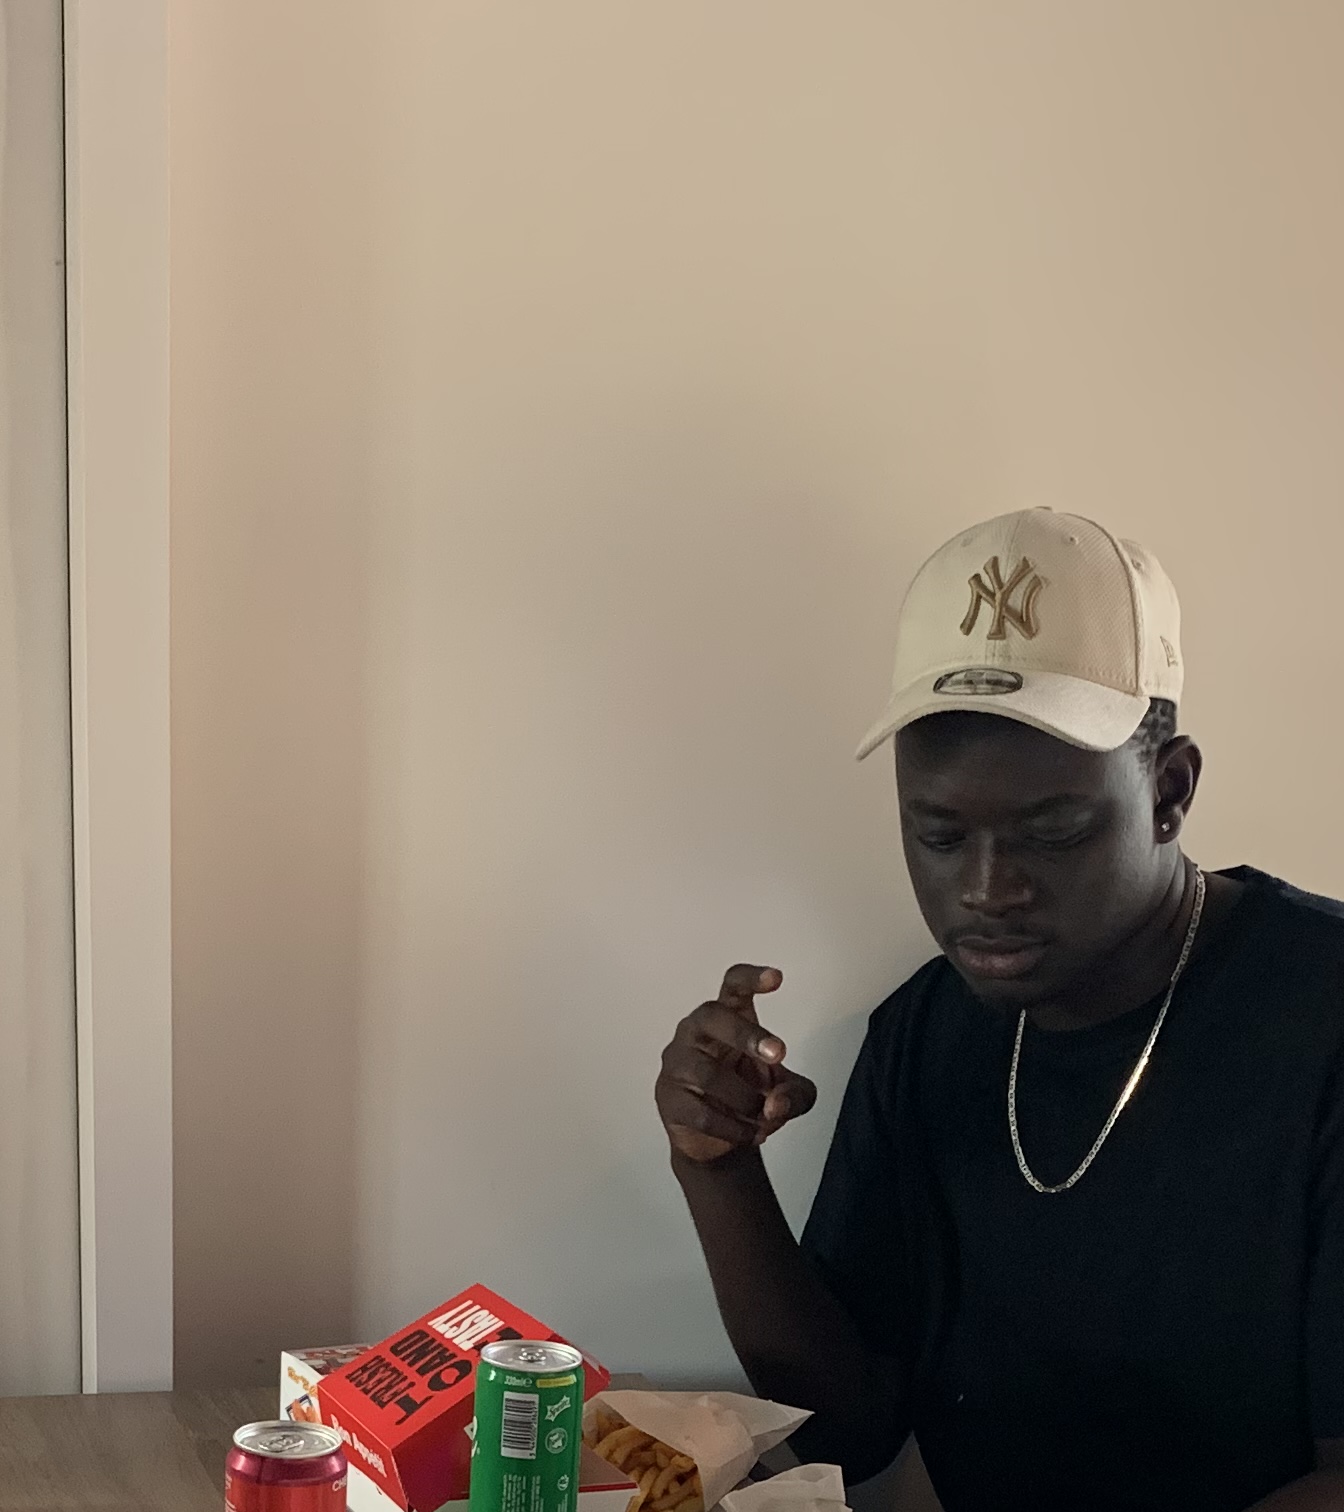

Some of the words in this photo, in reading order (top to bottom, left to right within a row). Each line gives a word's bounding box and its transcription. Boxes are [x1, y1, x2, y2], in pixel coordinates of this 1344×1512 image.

[959, 555, 1050, 641] NY
[428, 1300, 505, 1351] TASTY
[389, 1329, 457, 1376] AND
[345, 1355, 416, 1410] FRESH
